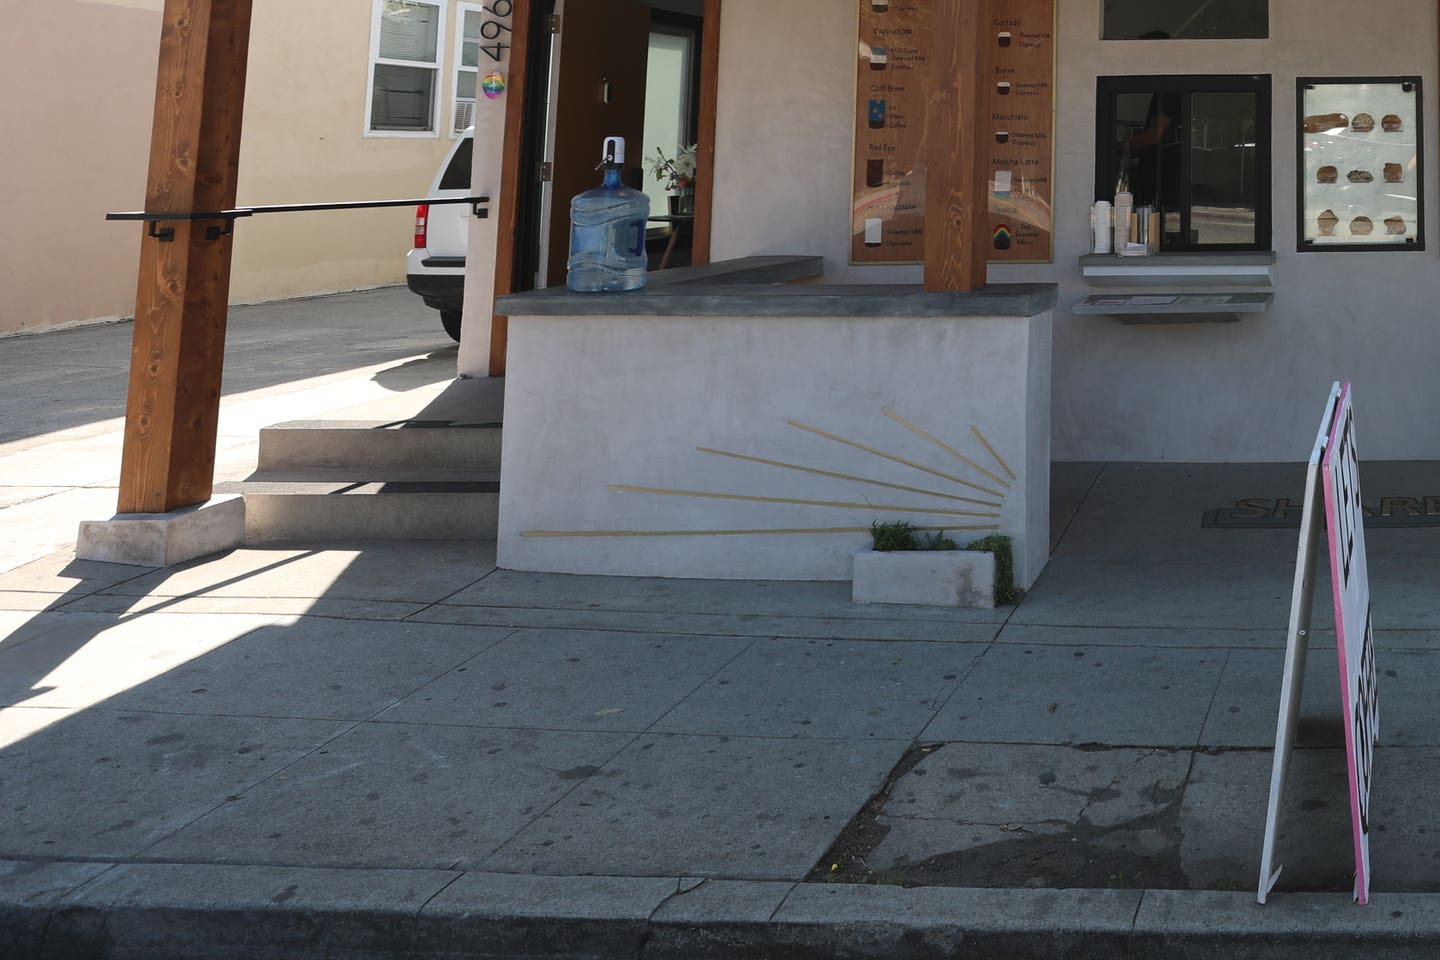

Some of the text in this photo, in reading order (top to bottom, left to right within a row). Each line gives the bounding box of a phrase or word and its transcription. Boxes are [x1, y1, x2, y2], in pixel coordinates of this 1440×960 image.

[992, 18, 1022, 26] Cortado
[994, 66, 1015, 74] Breve
[870, 84, 905, 92] Cold Brew
[992, 113, 1029, 121] Macchiato
[869, 144, 896, 153] Red Eye
[992, 158, 1040, 166] Matcha Latte
